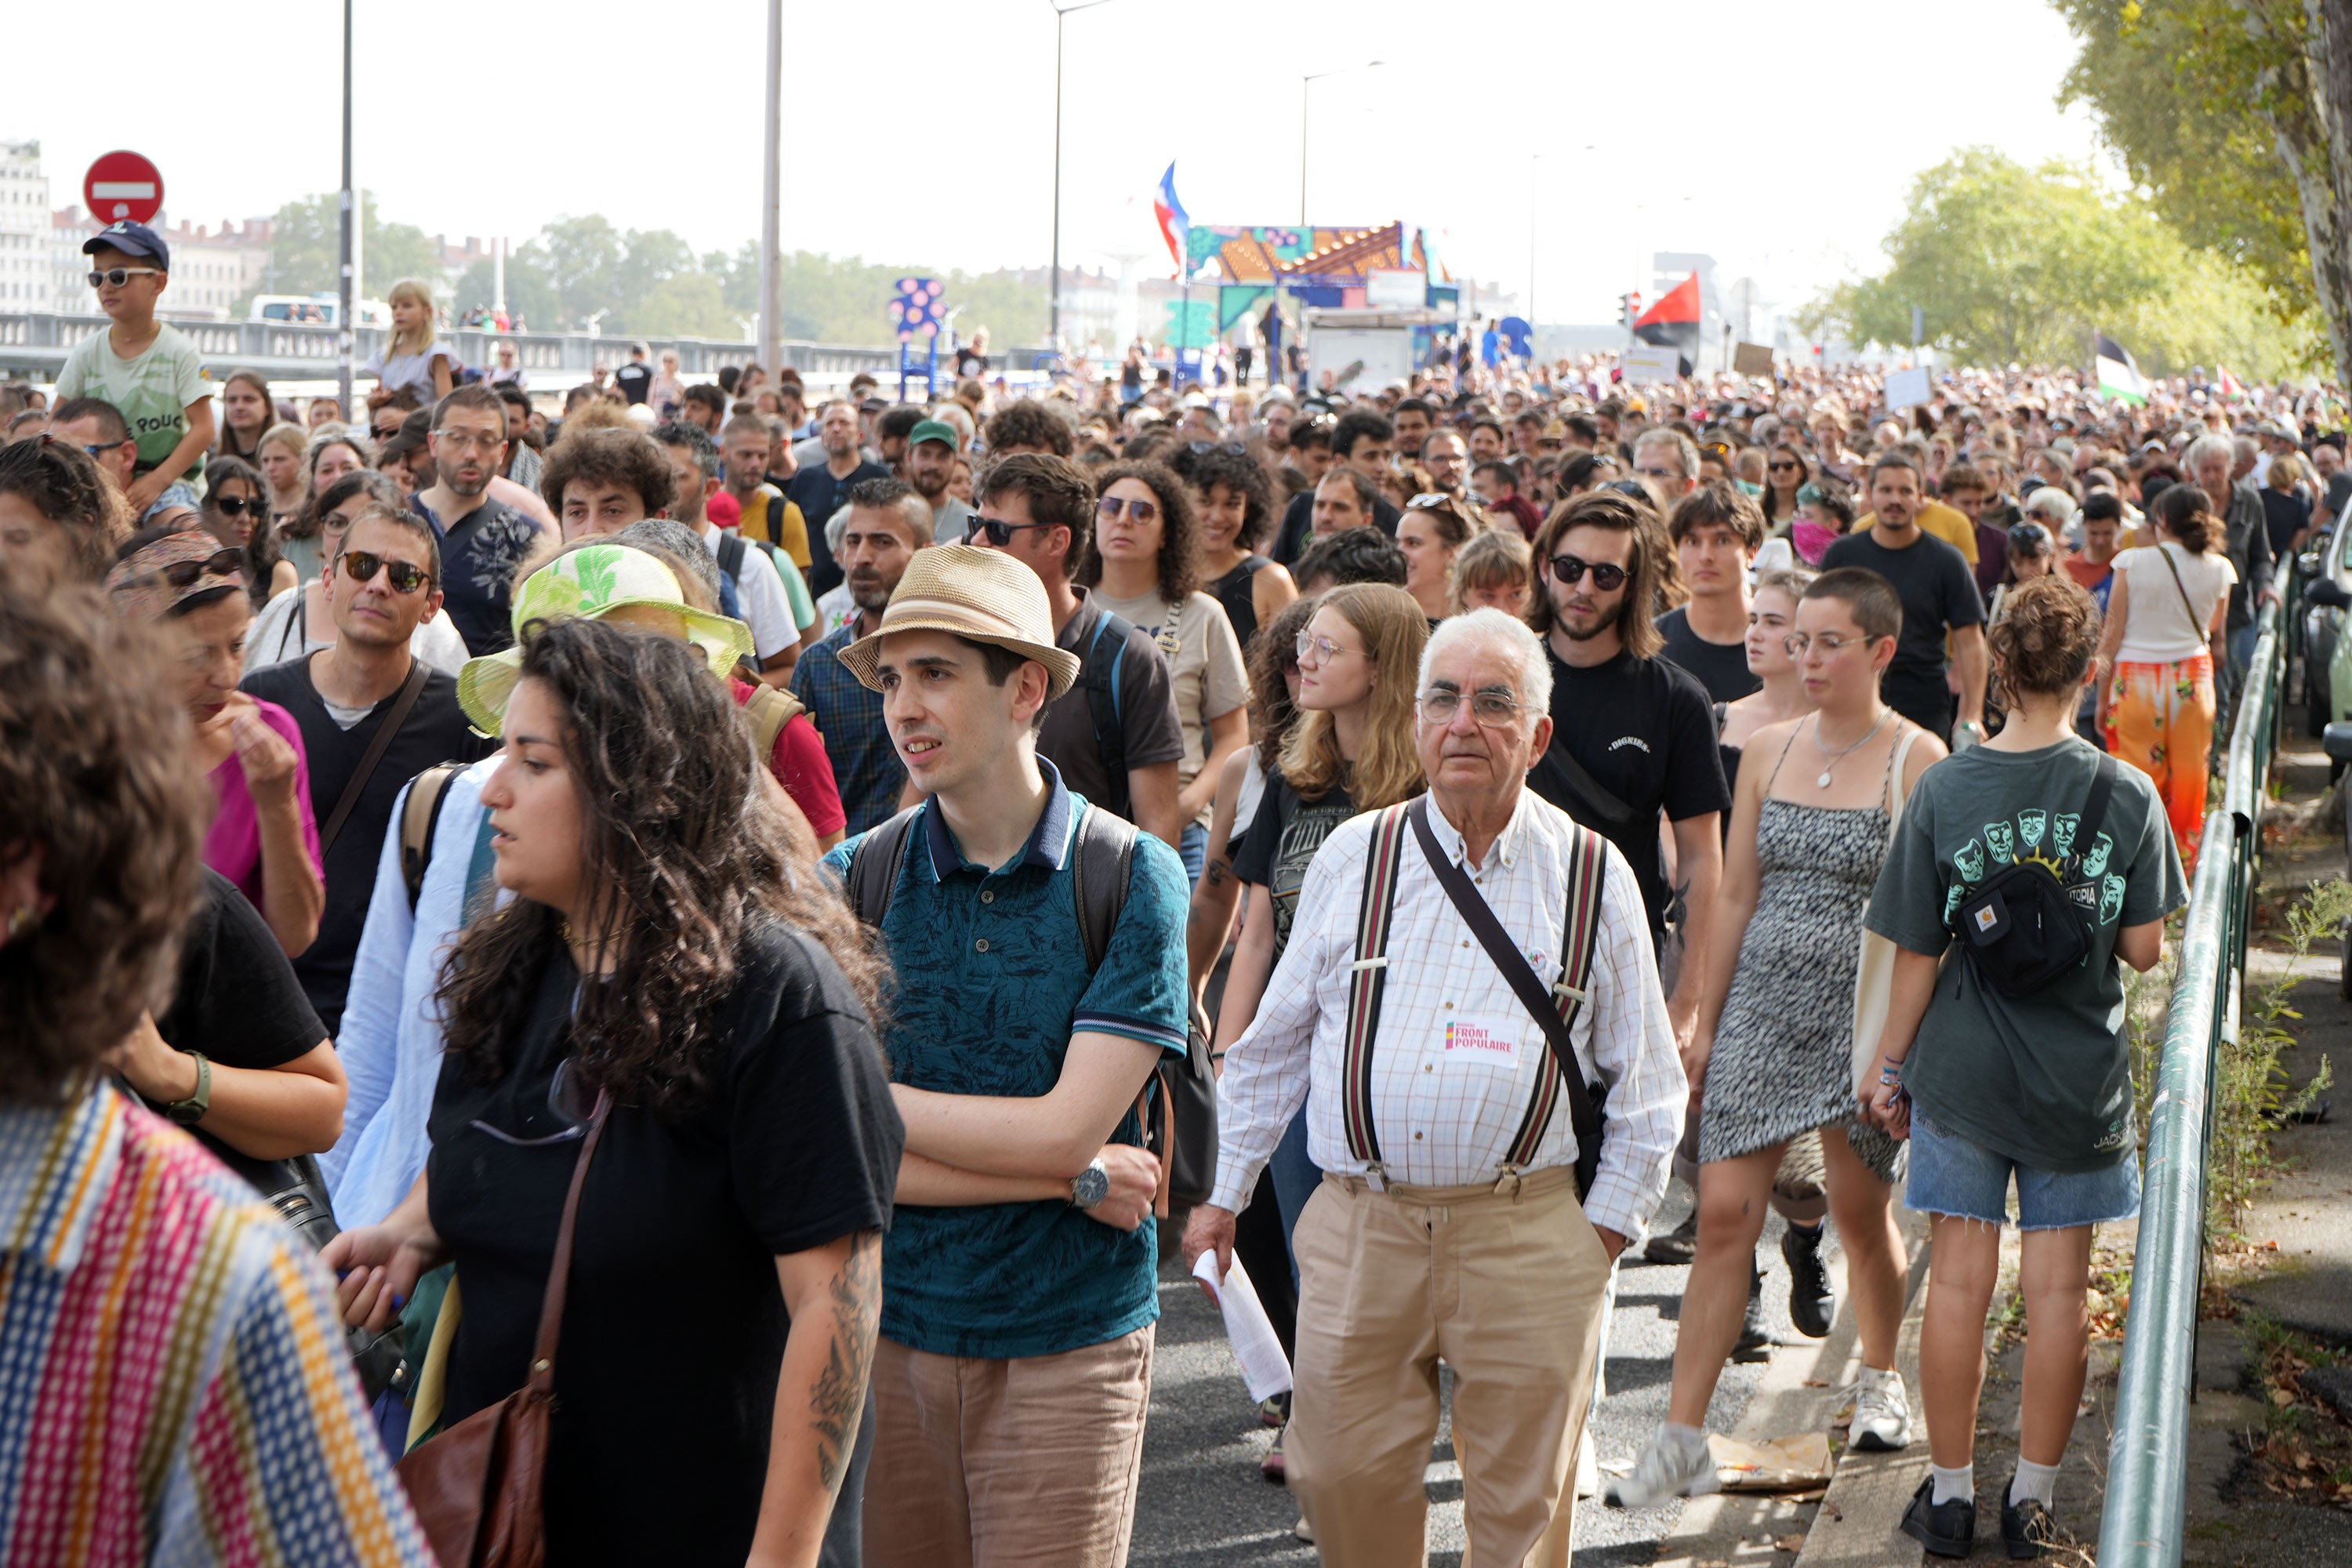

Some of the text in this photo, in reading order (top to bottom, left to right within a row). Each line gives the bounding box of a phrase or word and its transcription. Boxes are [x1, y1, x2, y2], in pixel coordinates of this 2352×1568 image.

[136, 414, 183, 433] POUC
[1611, 736, 1649, 753] DICKIES
[1455, 1028, 1489, 1038] FRONT
[1455, 1038, 1512, 1053] POPULAIRE
[2093, 1127, 2127, 1149] JACK
